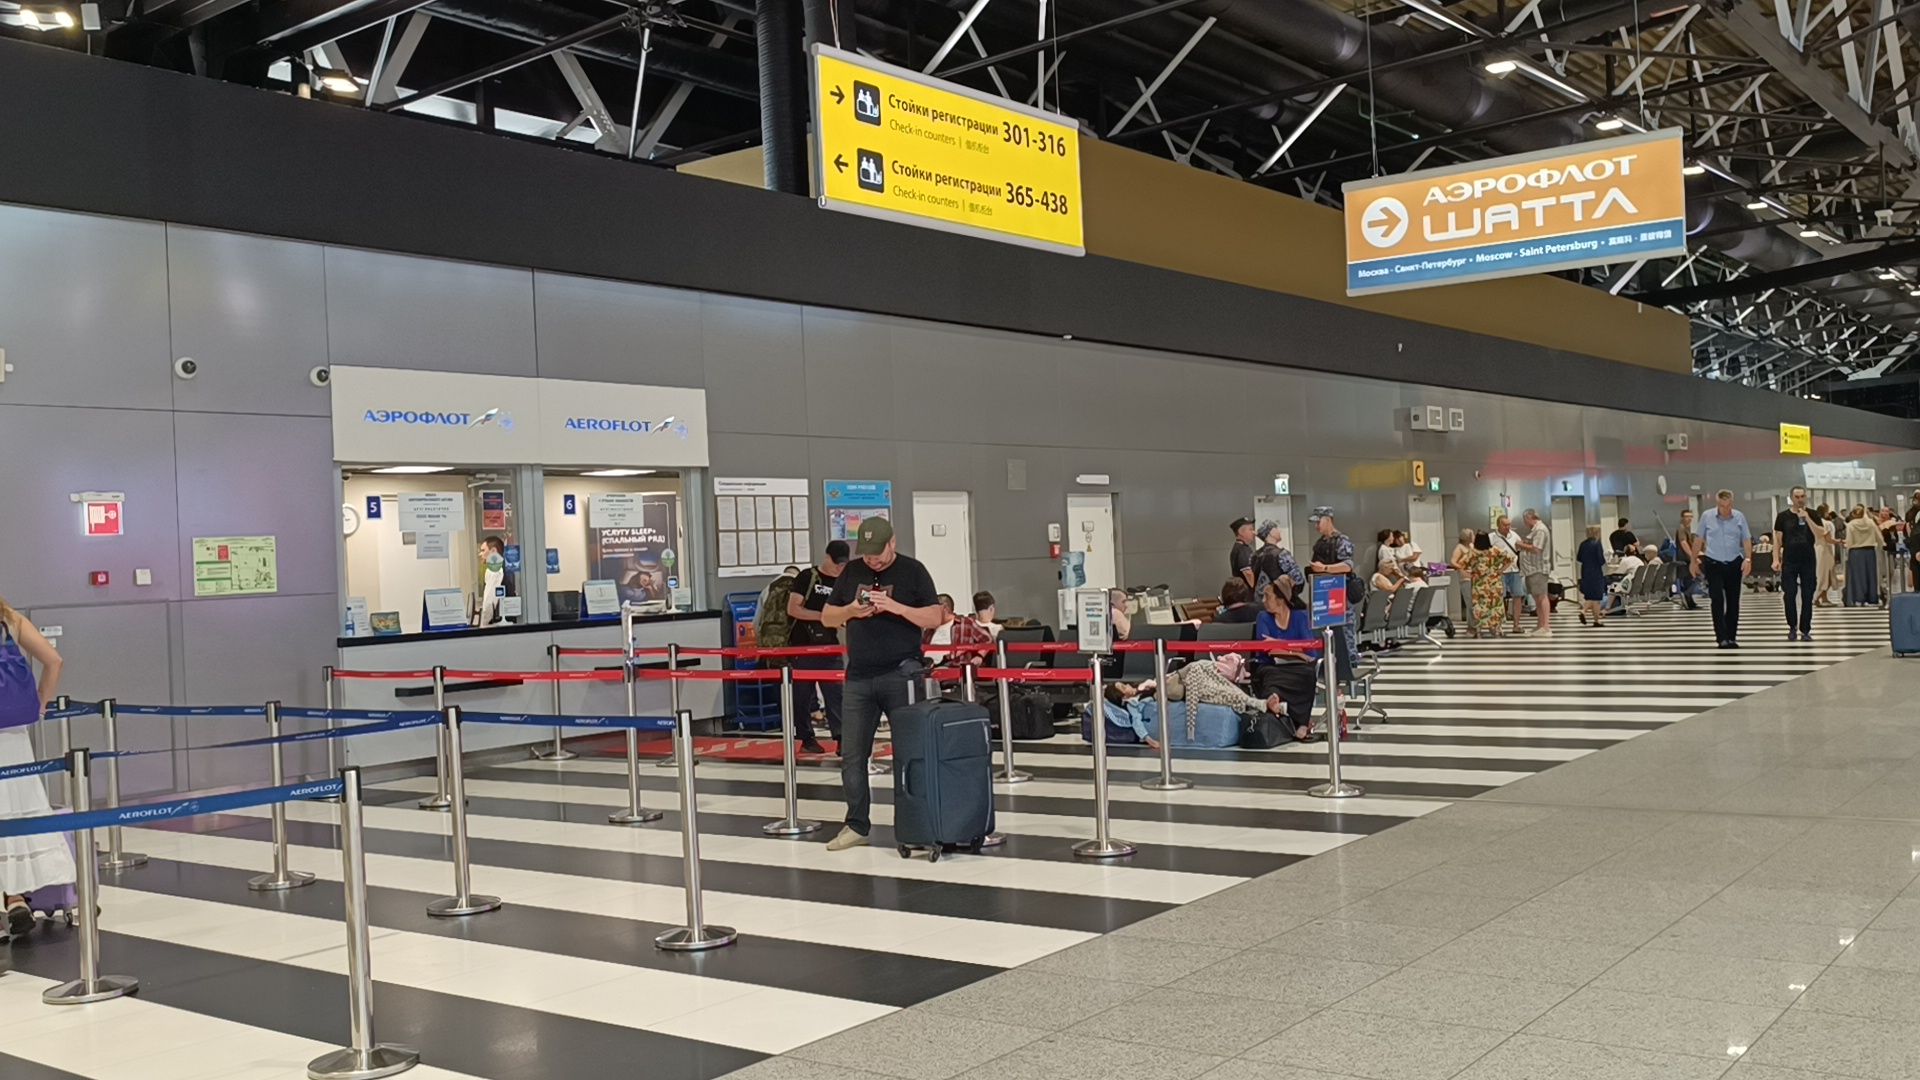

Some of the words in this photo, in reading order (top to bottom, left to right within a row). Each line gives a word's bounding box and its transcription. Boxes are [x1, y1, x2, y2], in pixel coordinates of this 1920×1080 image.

[888, 93, 929, 118] Стойки
[931, 109, 998, 136] регистрации
[1003, 121, 1066, 157] 301-316
[889, 118, 922, 137] Check-in
[923, 130, 956, 146] counters
[891, 160, 933, 182] Стойки
[935, 173, 1002, 197] регистрации
[1006, 182, 1068, 215] 365-438
[1422, 154, 1638, 207] АЭРОФЛОТ
[892, 184, 926, 201] Check-in
[927, 194, 959, 209] counters
[1422, 187, 1639, 242] ШАТТЛ
[1358, 267, 1389, 278] Москва
[1394, 257, 1467, 274] Санкт-Петербург
[1475, 251, 1513, 263] Moscow
[1519, 246, 1544, 258] Saint
[1545, 240, 1598, 254] Petersburg
[363, 409, 471, 425] АЭРОФЛОТ
[564, 417, 652, 432] AEROFLOT
[370, 501, 378, 513] 5
[566, 499, 573, 510] 6
[0, 765, 42, 776] AEROFLOT
[290, 784, 338, 796] AEROFLOT
[118, 807, 173, 819] AEROFLOT
